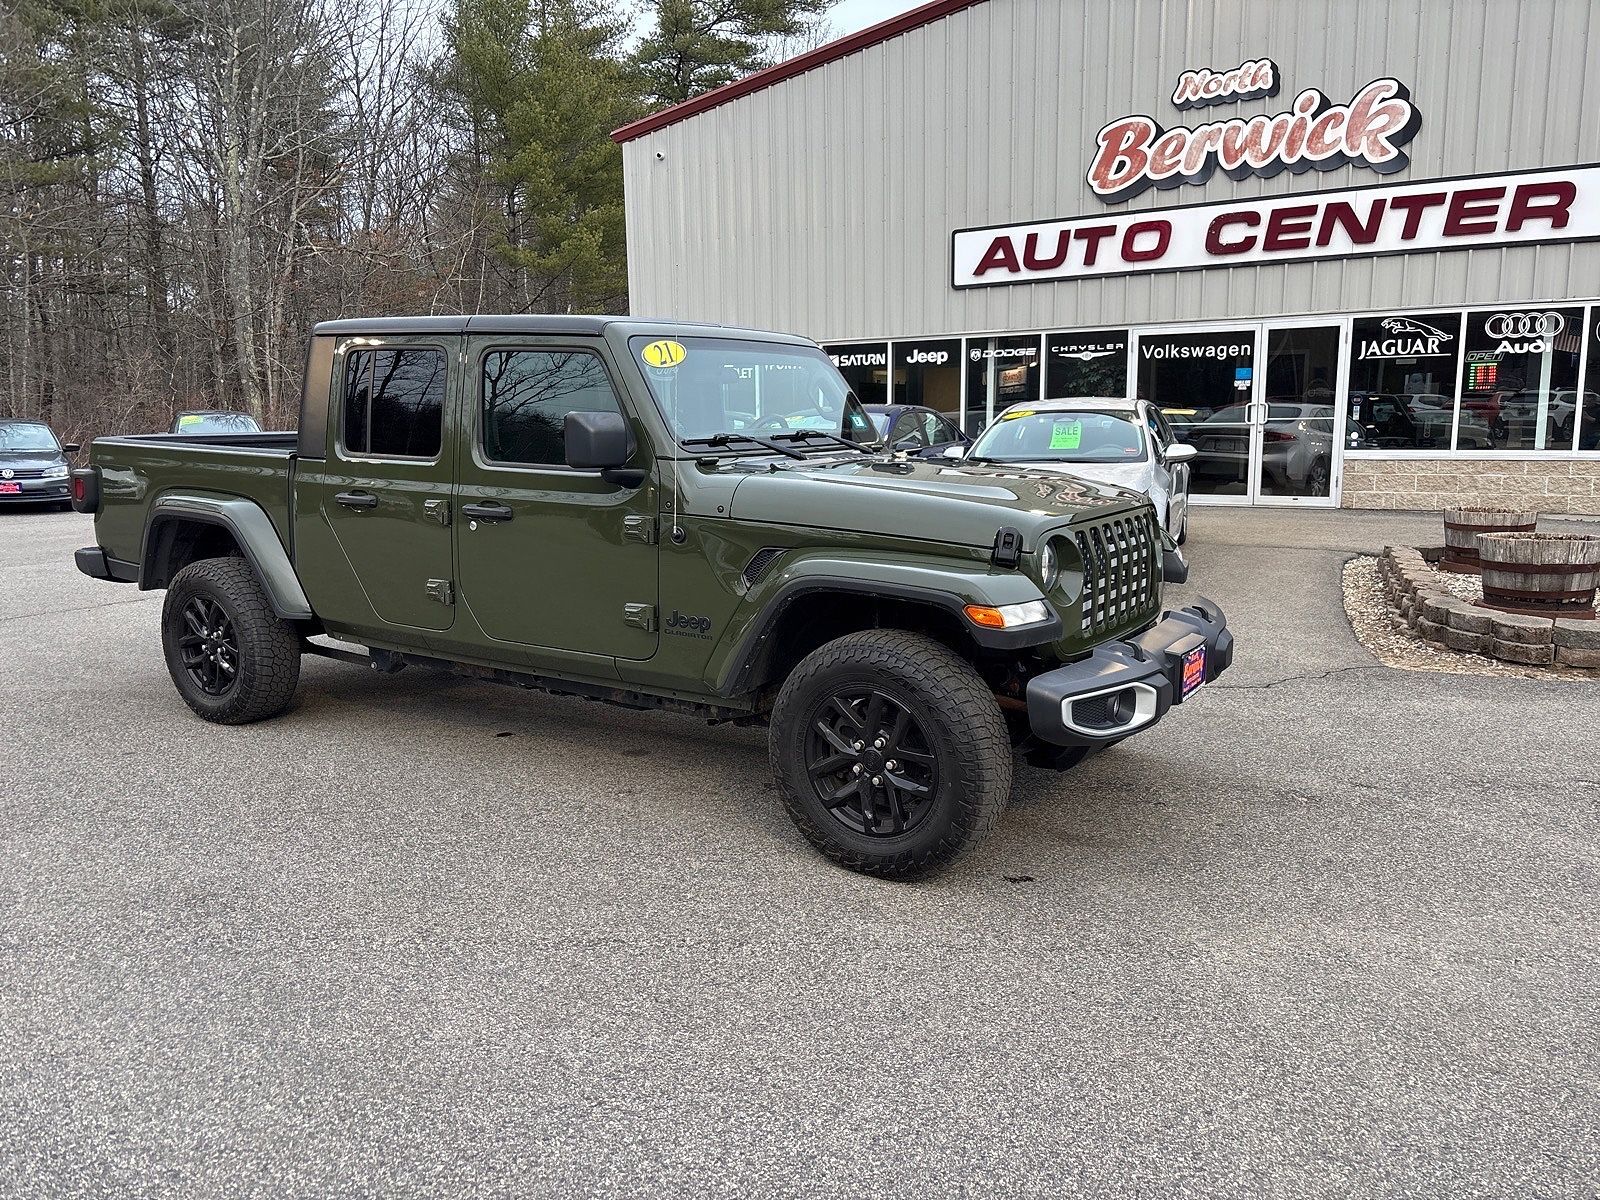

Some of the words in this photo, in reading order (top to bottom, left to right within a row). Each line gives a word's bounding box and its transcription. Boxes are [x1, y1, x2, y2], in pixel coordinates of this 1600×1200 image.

[1175, 60, 1272, 101] North
[1090, 82, 1407, 191] Berwick
[972, 219, 1171, 276] AUTO
[1204, 181, 1578, 256] CENTER
[653, 342, 674, 365] 21
[982, 347, 1037, 358] DODGE
[1051, 343, 1124, 352] CHRYSLER
[1142, 344, 1251, 360] Volkswagen
[1358, 338, 1440, 360] JAGUAR
[1494, 339, 1551, 354] Audi
[840, 353, 886, 367] SATURN
[906, 349, 949, 365] Jeep
[1467, 352, 1502, 361] OPEN
[1055, 426, 1079, 436] SALE
[666, 609, 712, 634] Jeep
[664, 628, 713, 641] GLADIATOR
